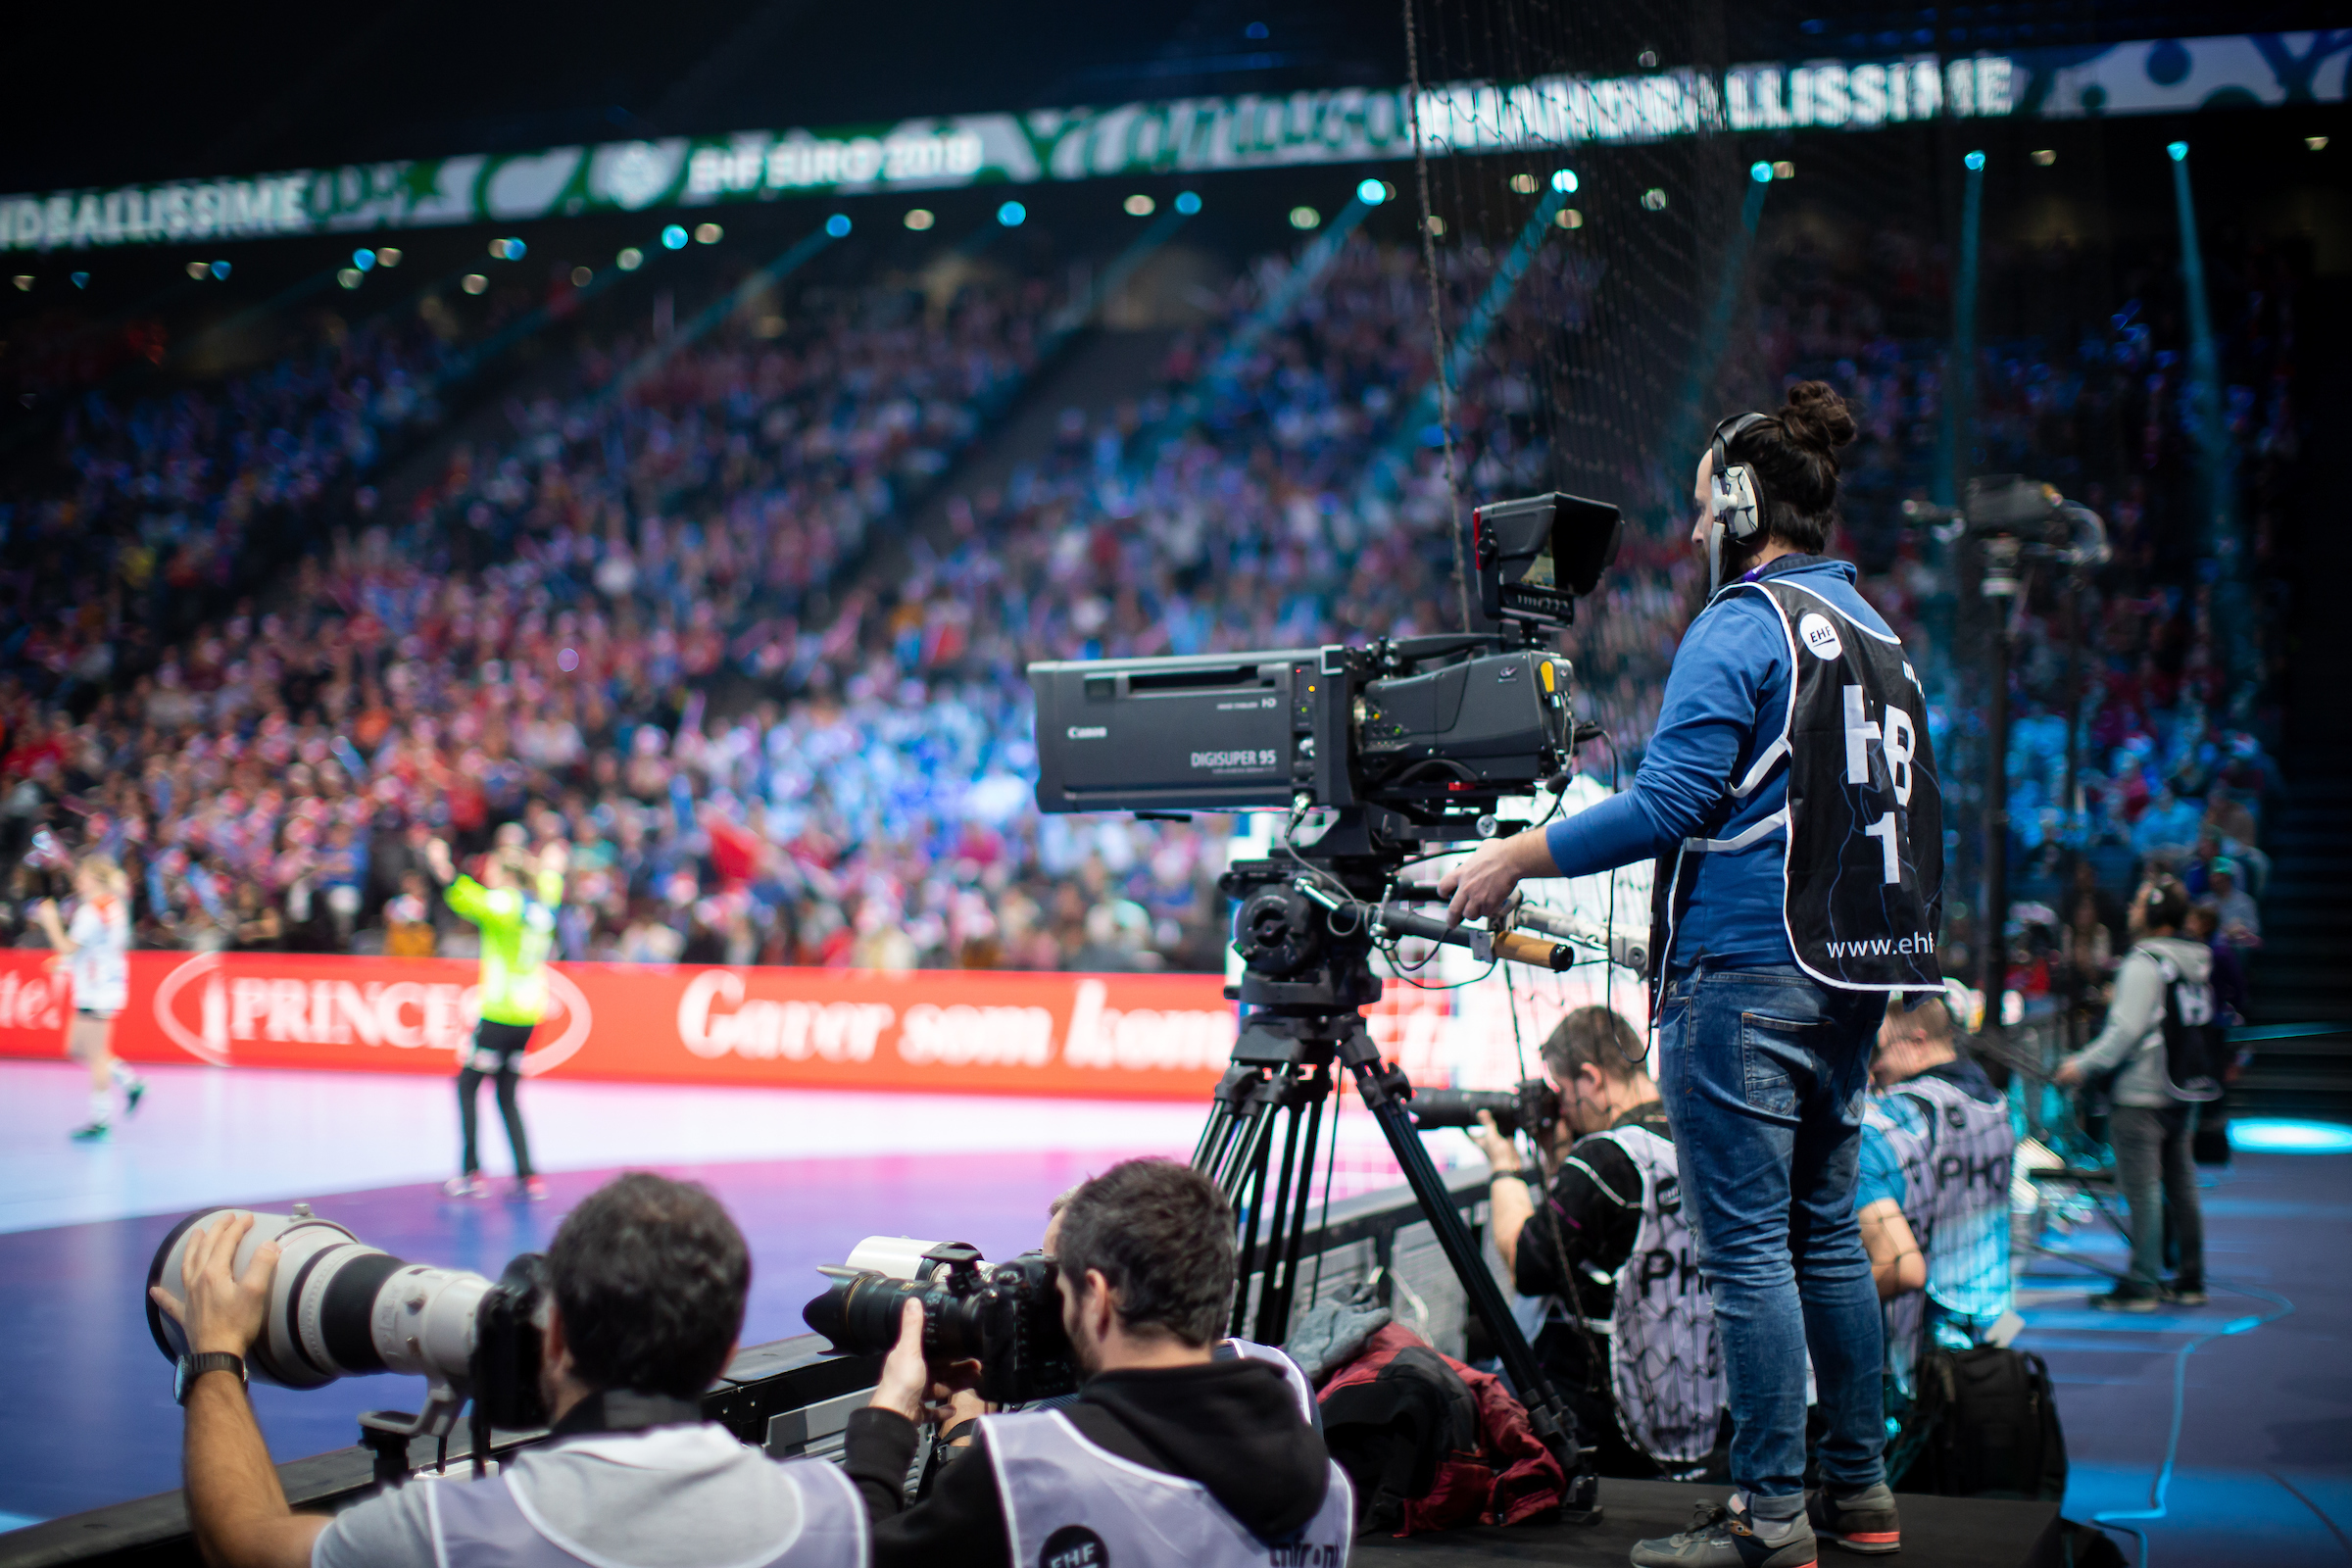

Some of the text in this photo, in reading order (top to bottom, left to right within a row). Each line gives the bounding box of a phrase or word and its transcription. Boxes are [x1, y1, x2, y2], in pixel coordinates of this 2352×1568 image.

[1809, 625, 1832, 643] EHF
[1191, 749, 1277, 767] DIGISUPER 95
[1865, 811, 1900, 884] 1
[230, 977, 481, 1050] PRINCE
[1062, 978, 1236, 1071] kom
